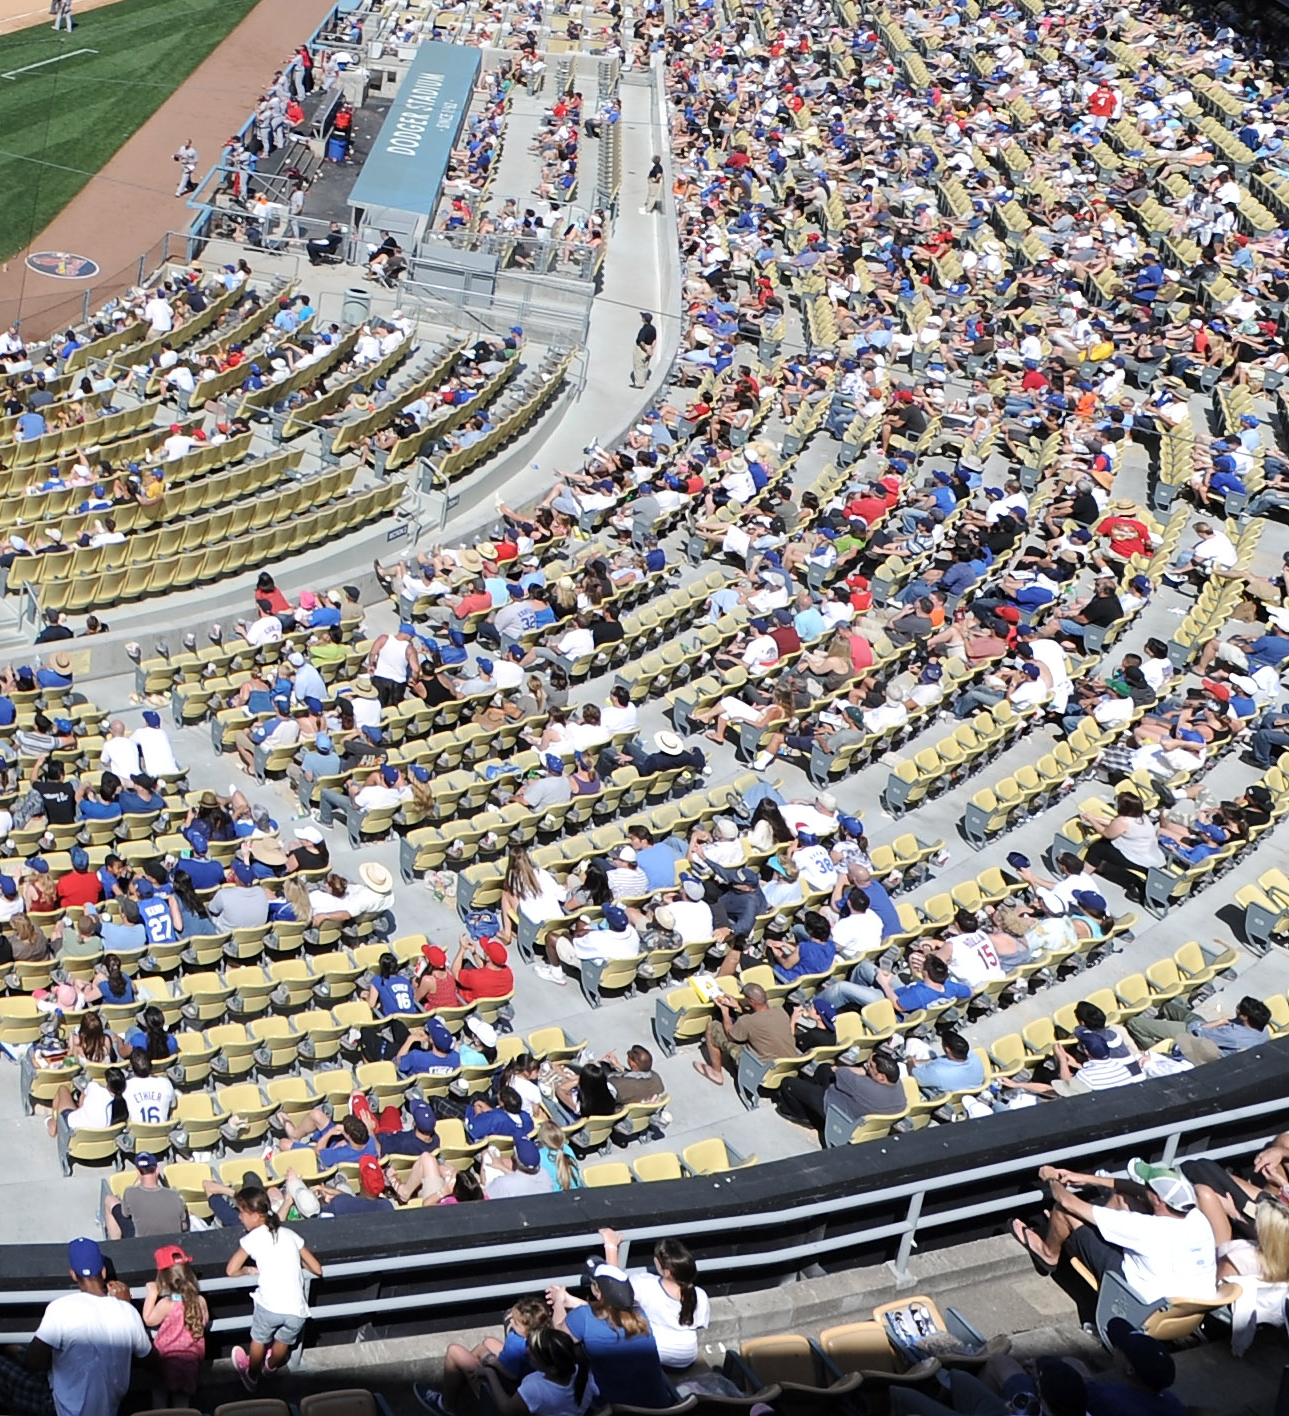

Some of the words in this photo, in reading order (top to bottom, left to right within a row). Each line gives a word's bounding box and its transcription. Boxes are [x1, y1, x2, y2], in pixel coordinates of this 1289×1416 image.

[405, 72, 445, 112] STADIUM
[386, 112, 430, 156] DODGER
[521, 616, 536, 631] 32
[815, 857, 834, 874] 38
[148, 913, 173, 942] 27
[977, 944, 998, 970] 15
[395, 992, 412, 1010] 16
[133, 1092, 161, 1104] ETHIER
[139, 1106, 160, 1124] 16
